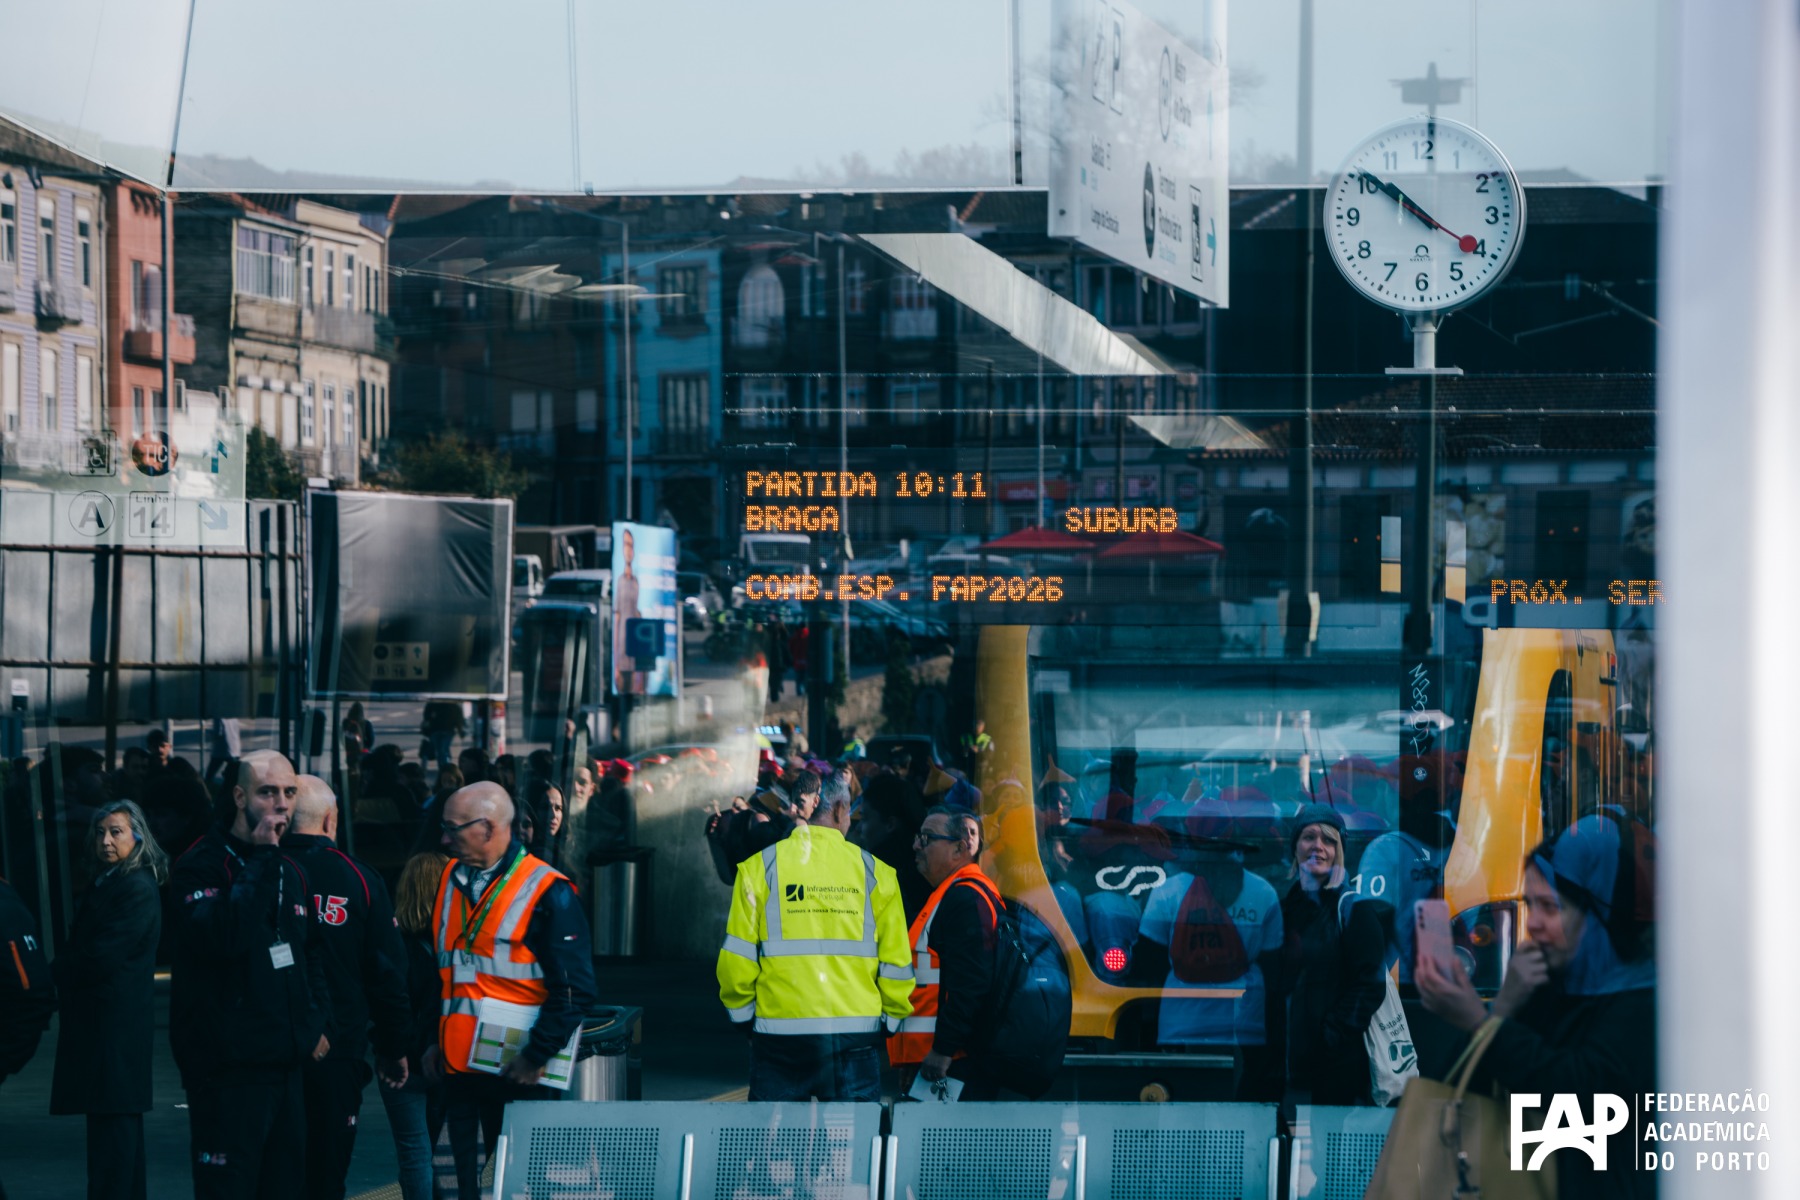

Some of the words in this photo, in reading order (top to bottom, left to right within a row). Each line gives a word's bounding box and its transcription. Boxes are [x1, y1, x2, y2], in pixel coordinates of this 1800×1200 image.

[1412, 140, 1434, 160] 12
[1453, 150, 1459, 170] 1
[1383, 151, 1398, 170] 11
[1357, 173, 1379, 195] 10
[1475, 173, 1489, 193] 2
[1346, 207, 1360, 226] 9
[1485, 206, 1499, 225] 3
[1357, 240, 1372, 259] 8
[1472, 238, 1487, 258] 4
[1383, 262, 1398, 282] 7
[1449, 262, 1463, 281] 5
[1415, 272, 1429, 292] 6
[143, 444, 168, 463] TIC
[746, 471, 877, 497] PARTIDA
[896, 472, 986, 497] 10:11
[79, 501, 105, 528] A
[133, 507, 171, 534] 14
[746, 505, 839, 531] BRAGA
[1065, 507, 1178, 533] SUBURB
[746, 575, 909, 600] COMB.ESP.
[932, 575, 1064, 601] FAP2026
[806, 885, 860, 894] Infraestruturas
